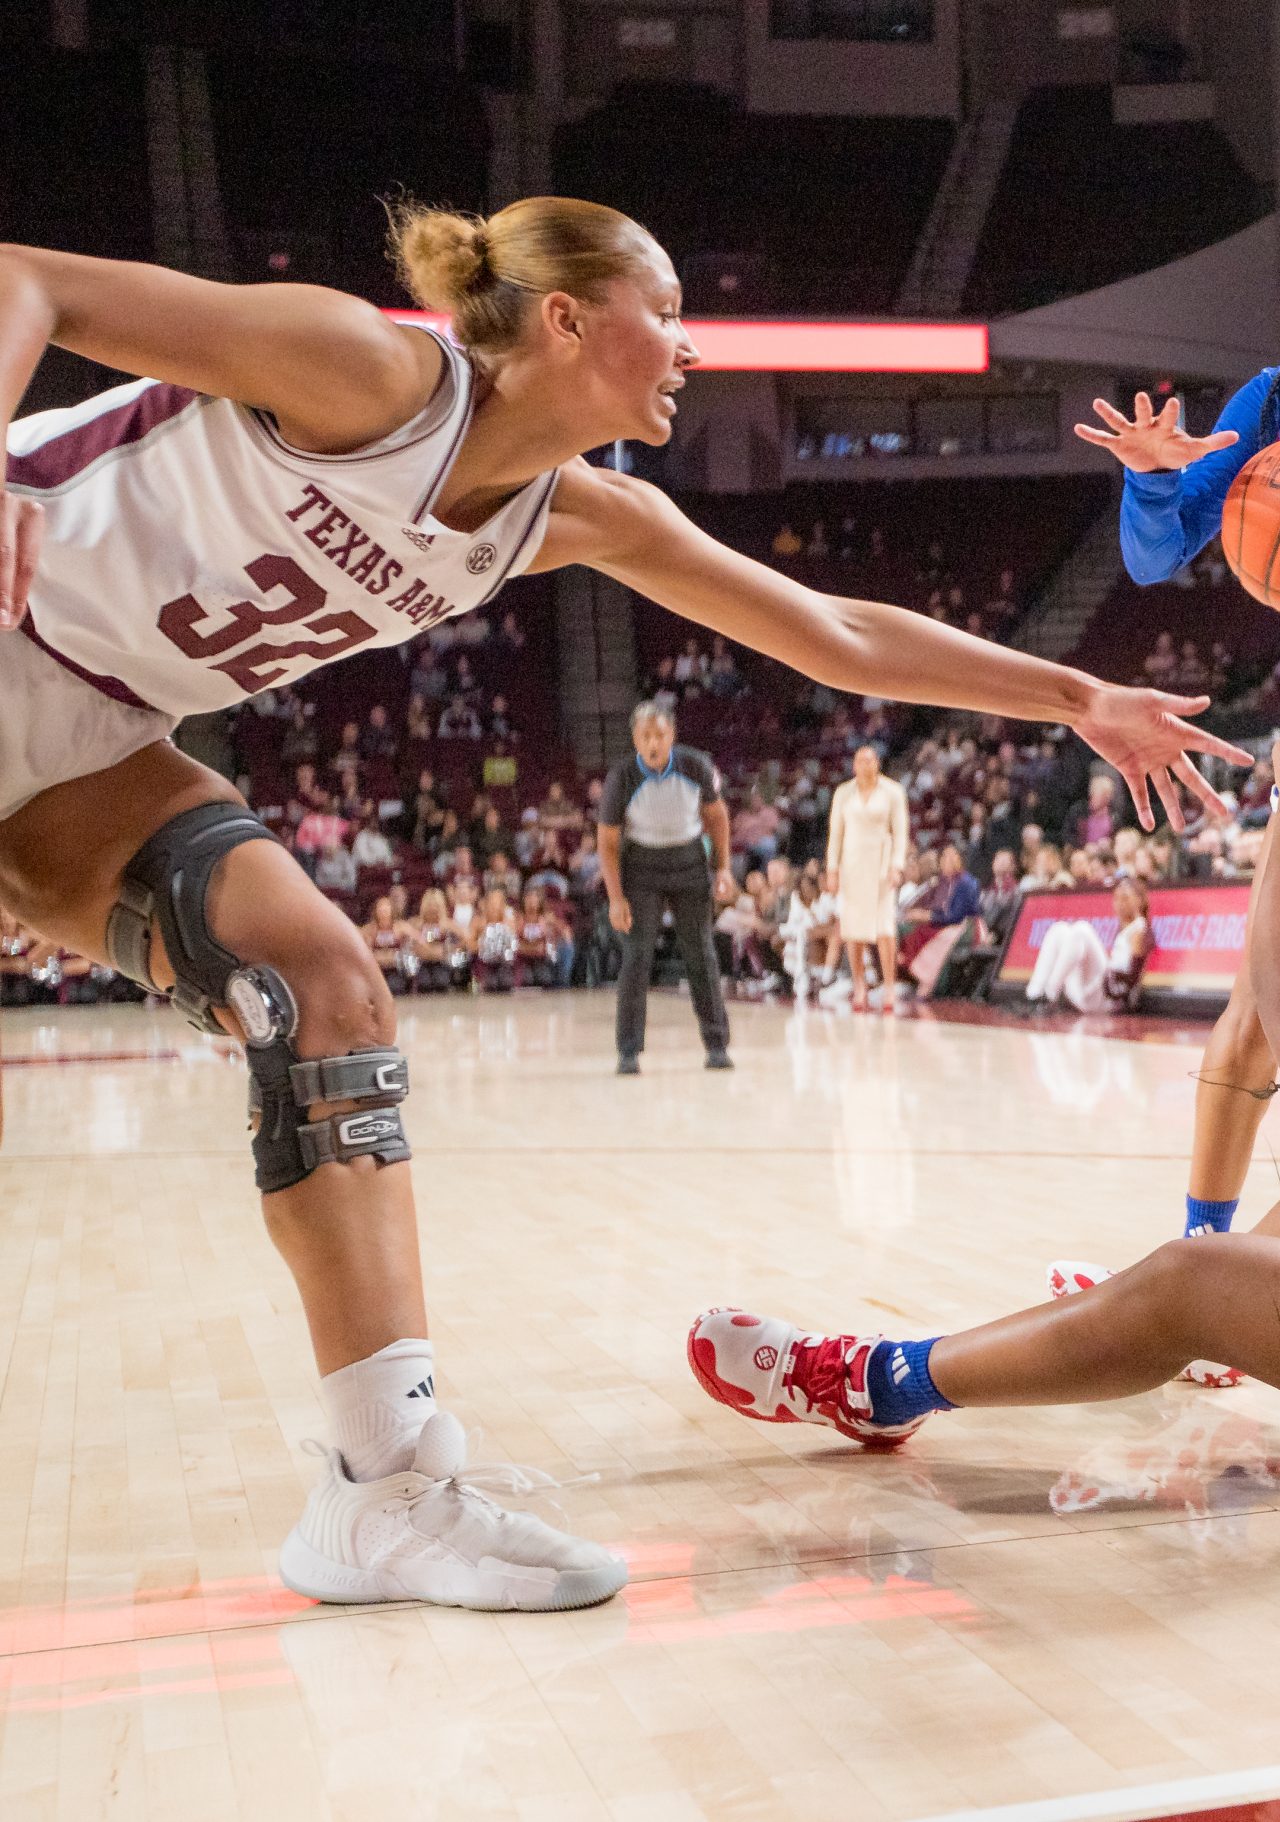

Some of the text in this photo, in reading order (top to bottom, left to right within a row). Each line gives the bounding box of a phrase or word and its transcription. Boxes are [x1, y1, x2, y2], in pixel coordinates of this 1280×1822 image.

[156, 553, 378, 694] 32
[285, 483, 456, 631] TEXAS A&M
[1151, 914, 1204, 950] WELLS
[1200, 913, 1249, 950] FARG
